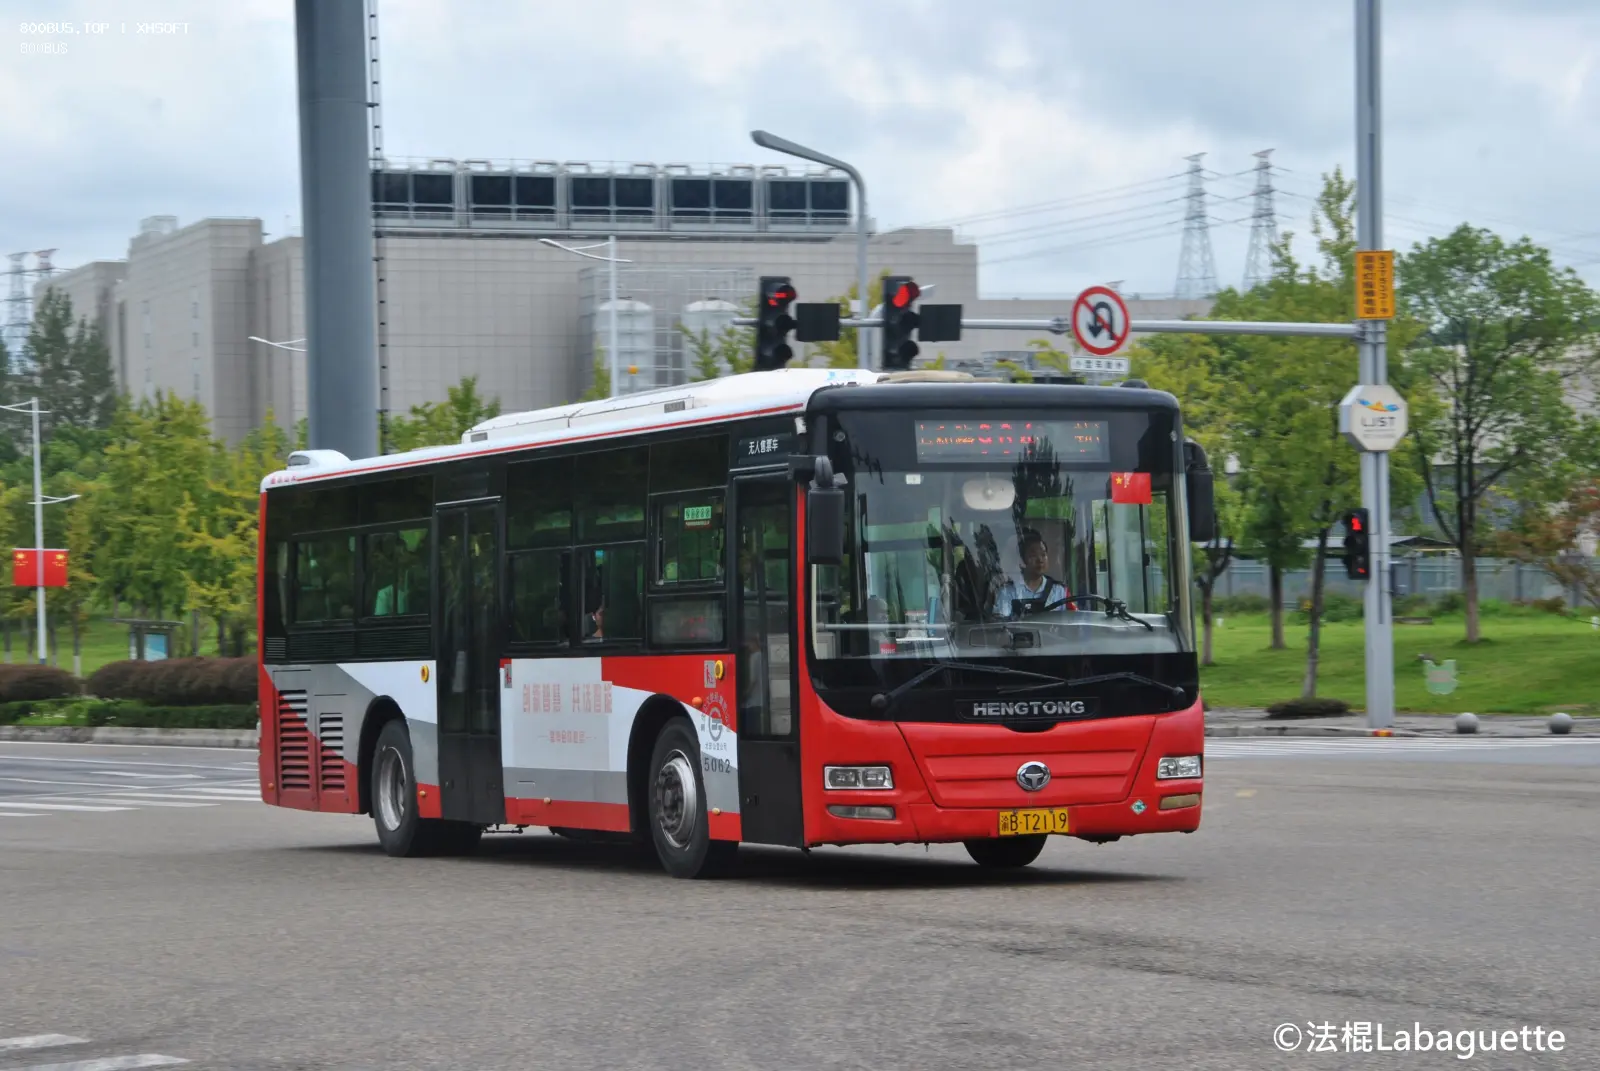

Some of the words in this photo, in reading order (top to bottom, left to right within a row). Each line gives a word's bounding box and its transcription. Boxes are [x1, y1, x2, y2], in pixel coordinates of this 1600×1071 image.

[748, 438, 779, 454] 无人售票车
[973, 701, 1085, 716] HENGTONG
[704, 757, 731, 774] 5062
